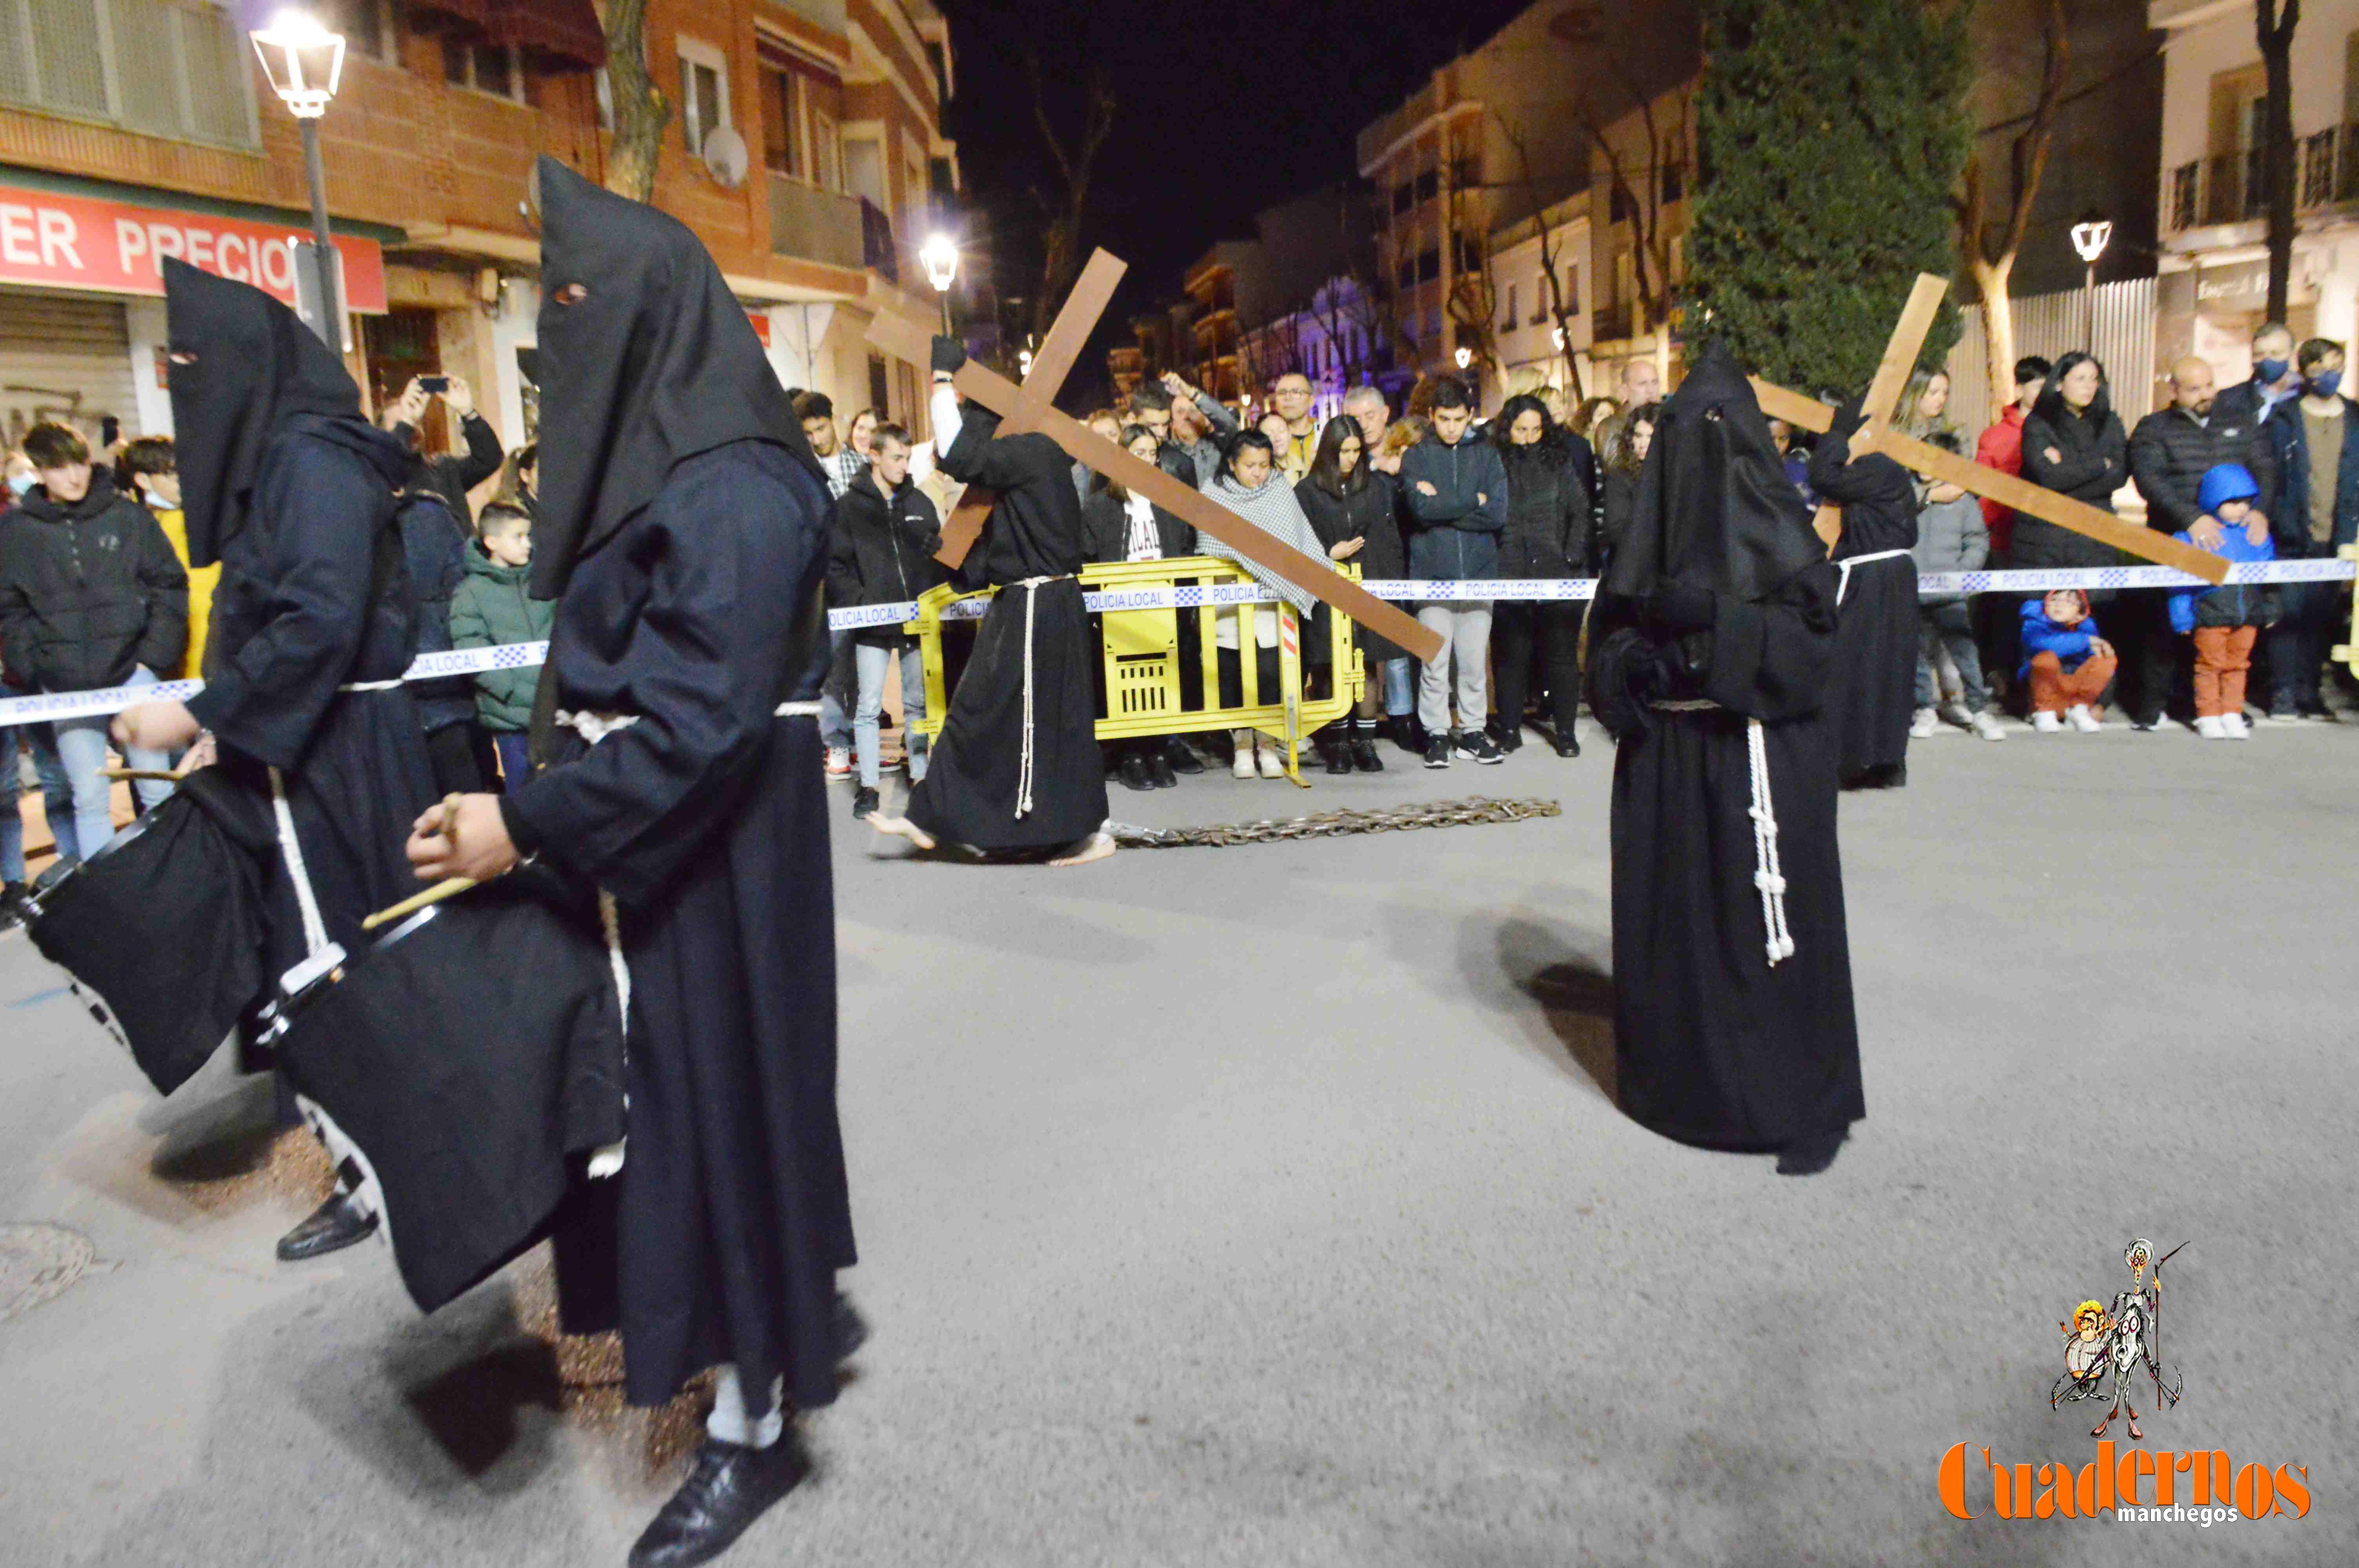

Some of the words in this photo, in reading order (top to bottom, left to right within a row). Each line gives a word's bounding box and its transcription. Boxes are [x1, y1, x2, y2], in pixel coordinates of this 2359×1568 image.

[1213, 587, 1254, 601] POLICIA
[1380, 583, 1415, 596] LOCAL
[1466, 583, 1507, 597] POLICIA
[1511, 583, 1547, 596] LOCAL
[1129, 592, 1164, 607] LOCAL
[866, 608, 900, 623] LOCAL
[436, 653, 480, 672] LOCAL
